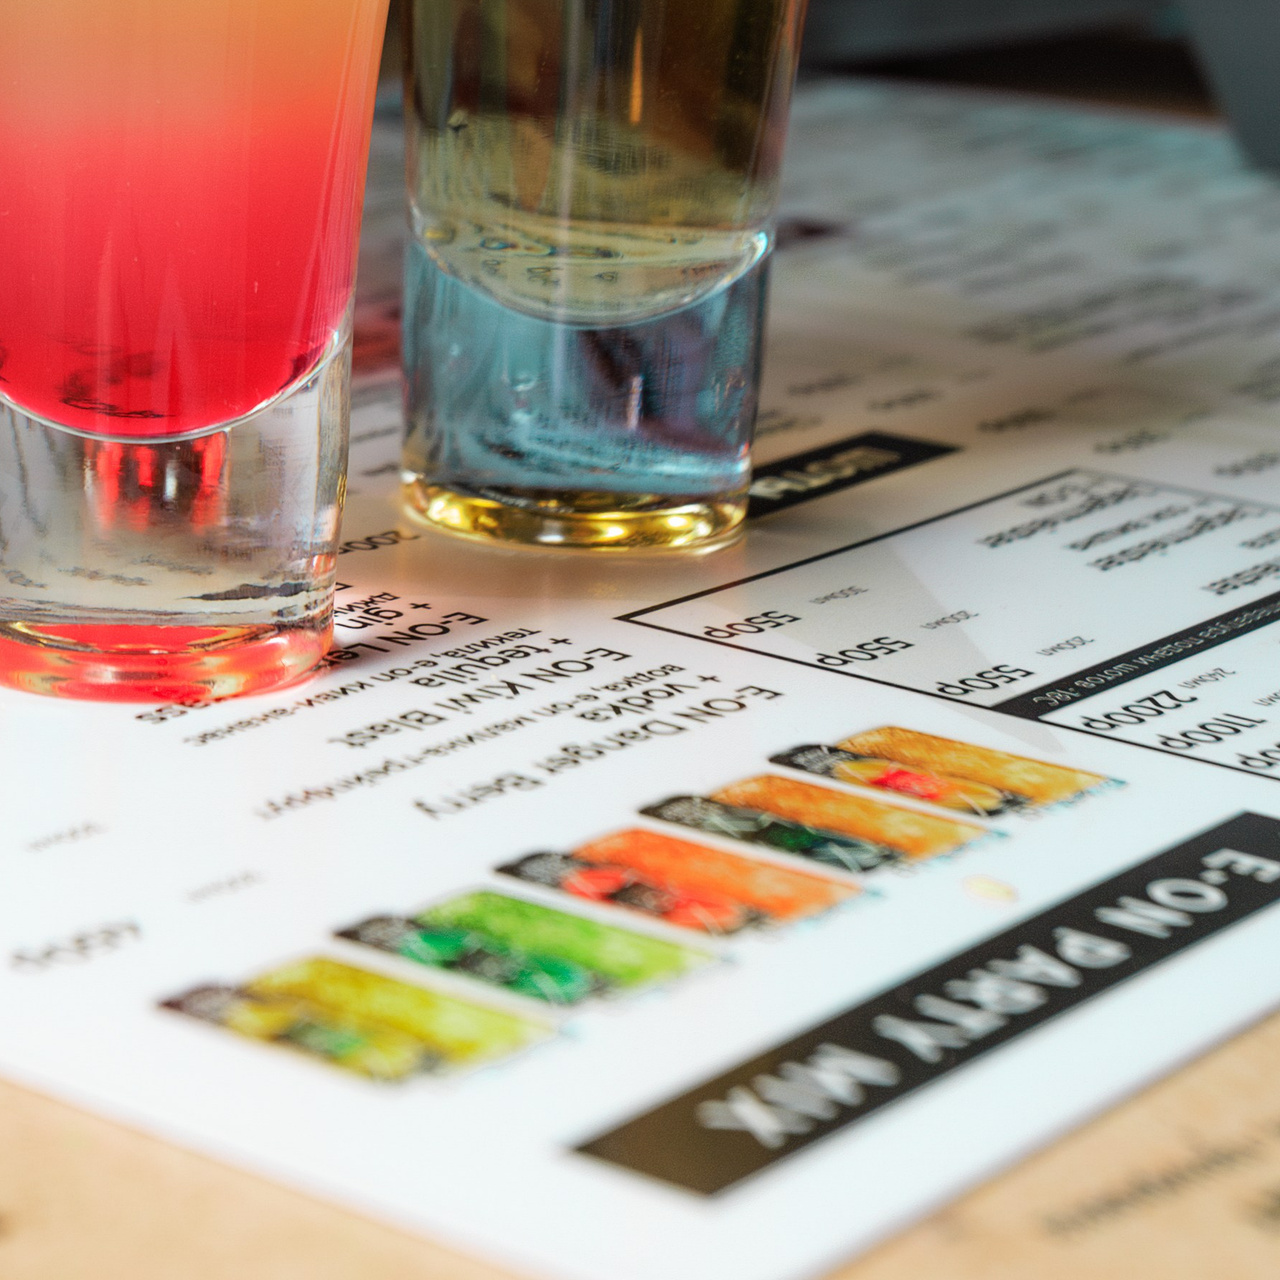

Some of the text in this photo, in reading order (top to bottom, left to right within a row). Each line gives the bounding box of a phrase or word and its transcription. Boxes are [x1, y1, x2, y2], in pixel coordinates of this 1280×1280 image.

[335, 607, 404, 630] gin
[375, 612, 489, 647] E-ON
[704, 610, 802, 641] 550р
[431, 627, 542, 661] текила,
[816, 636, 915, 668] 550р
[408, 641, 555, 690] tequila
[589, 663, 687, 696] водка,
[934, 664, 1034, 697] 550р
[328, 646, 631, 751] E-ON Kiwi Blast
[575, 683, 696, 724] vodka
[1081, 690, 1198, 732] 2200р
[1157, 712, 1267, 752] 1100р
[412, 684, 783, 821] E-ON Danger Berry
[871, 928, 1133, 1064] PARTY
